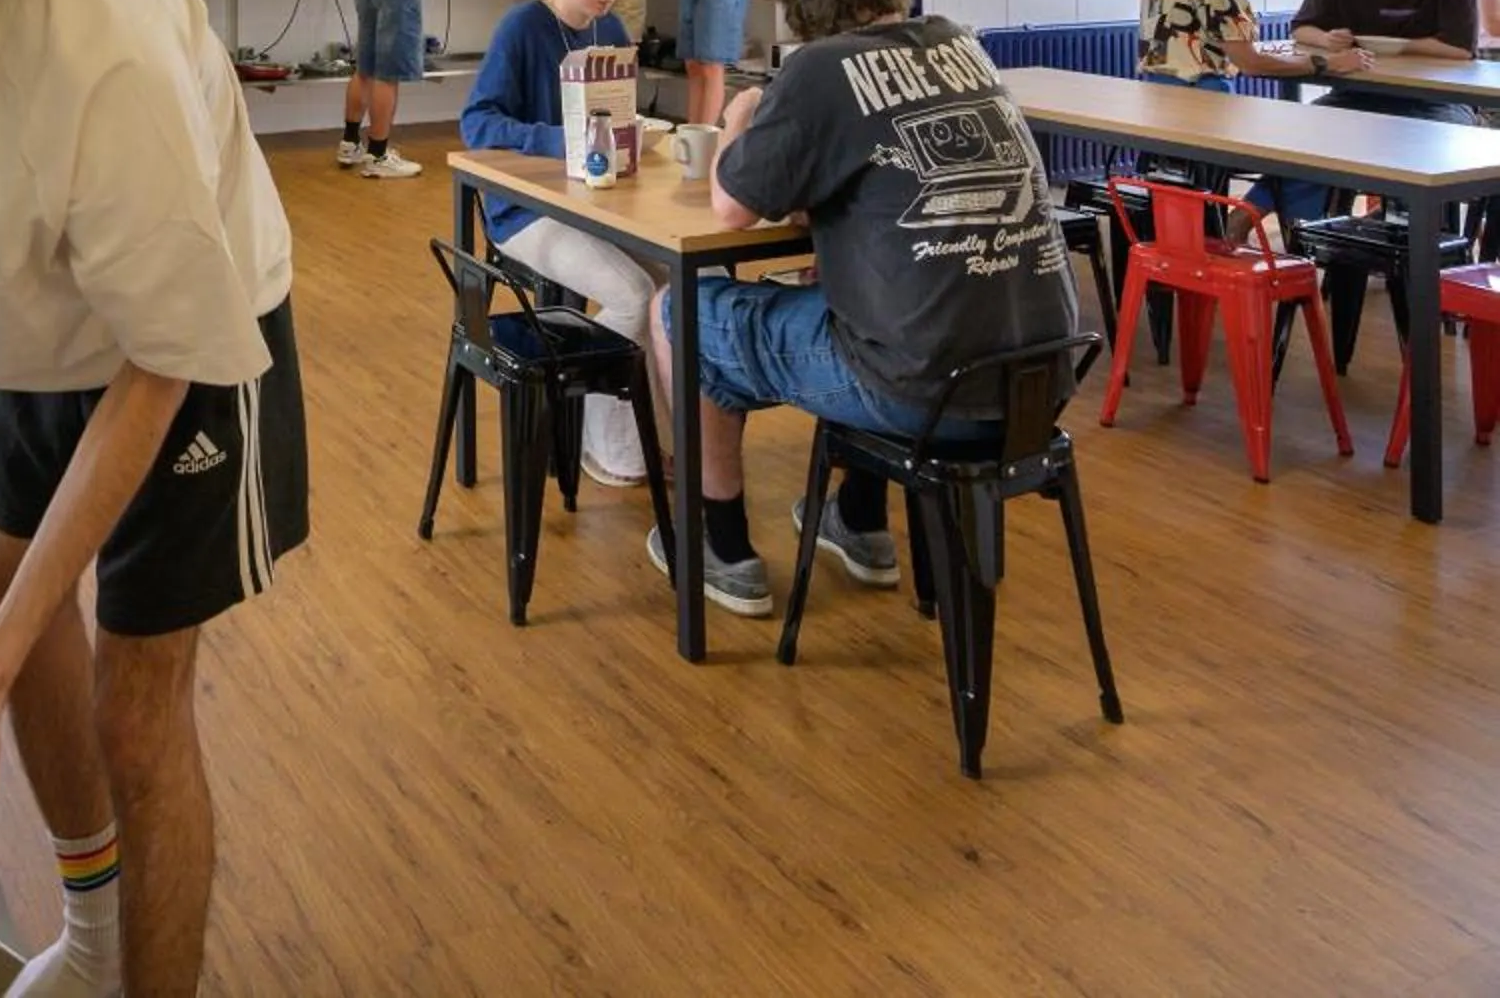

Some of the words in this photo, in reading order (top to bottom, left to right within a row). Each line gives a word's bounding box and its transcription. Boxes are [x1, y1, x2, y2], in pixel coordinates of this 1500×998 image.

[841, 46, 941, 117] NEUE
[911, 232, 987, 262] Friendly
[172, 450, 228, 475] adidas
